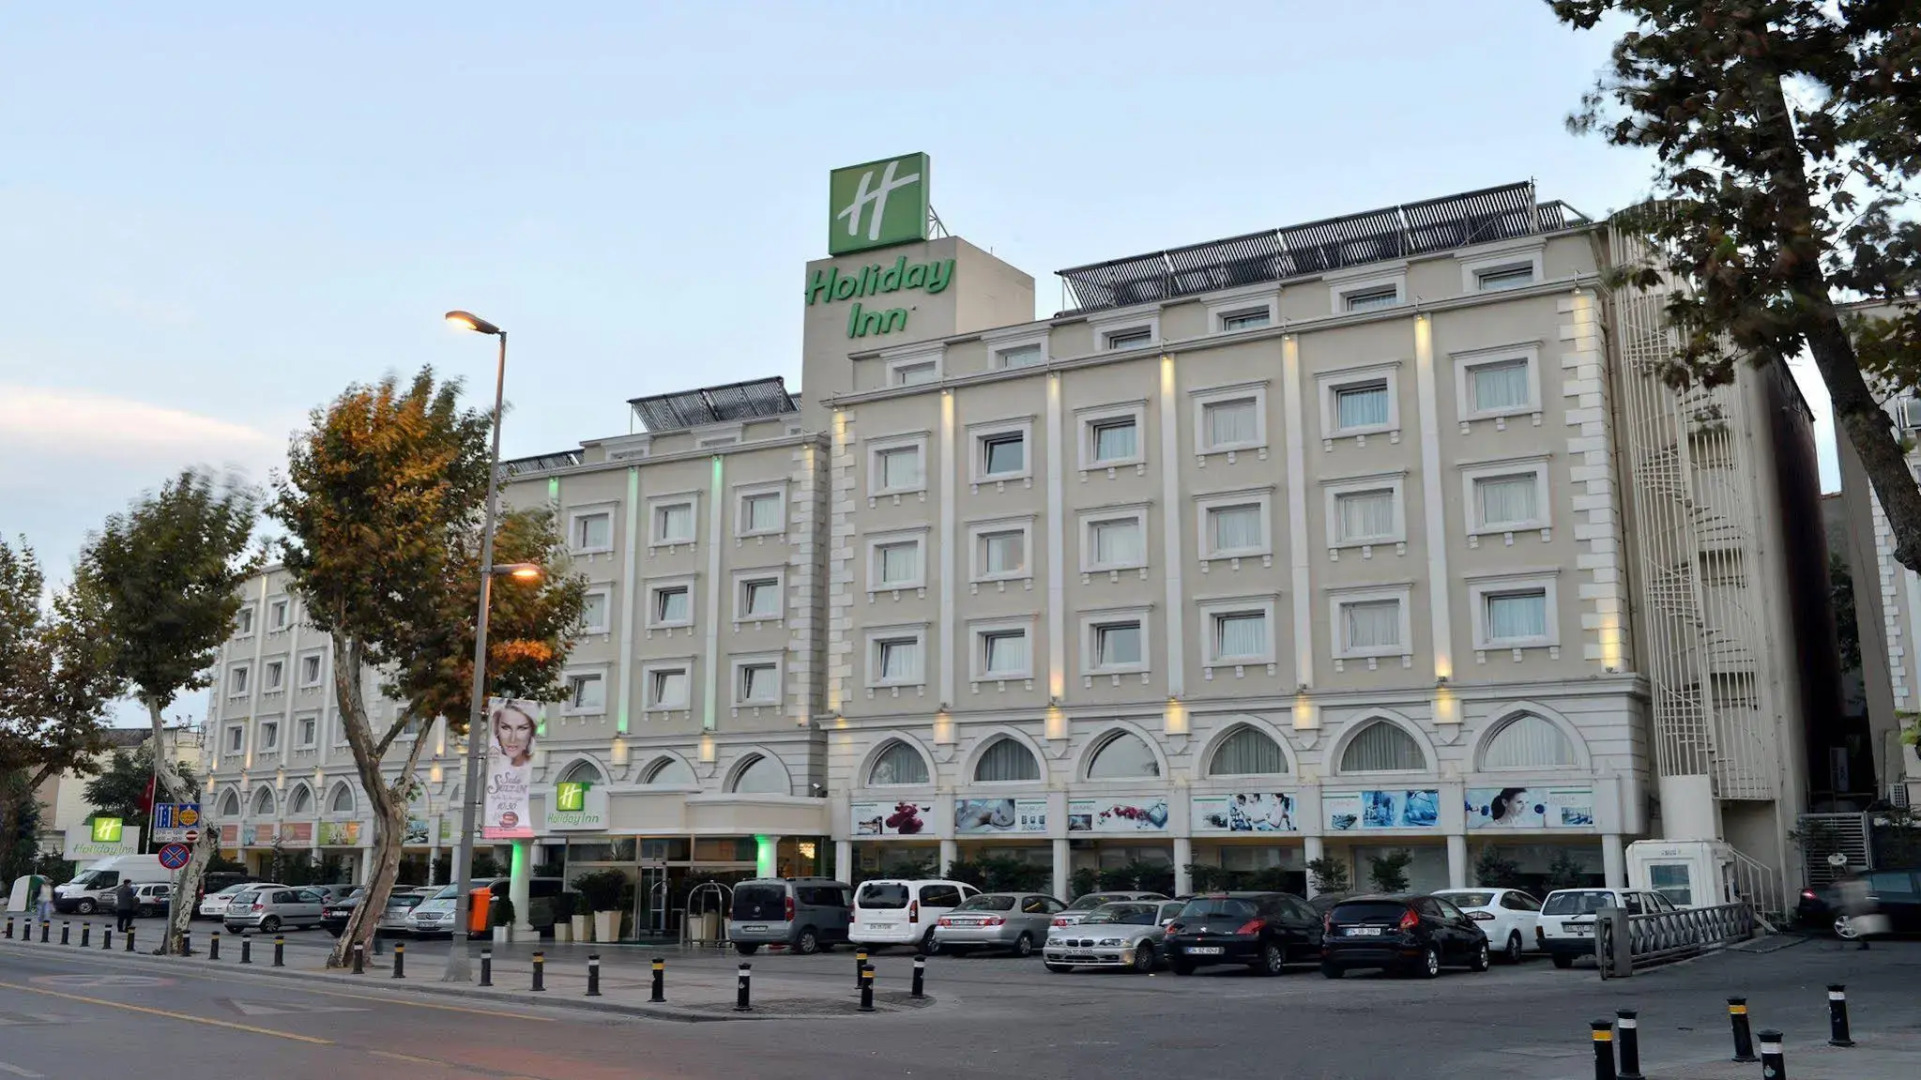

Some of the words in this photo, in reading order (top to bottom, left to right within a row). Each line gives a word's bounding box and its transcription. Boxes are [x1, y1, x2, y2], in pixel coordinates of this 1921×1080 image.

[837, 160, 920, 241] H
[806, 255, 956, 306] Holiday
[847, 302, 908, 339] Inn
[547, 812, 581, 826] Holiday
[581, 812, 600, 823] Inn
[74, 844, 117, 856] Holiday
